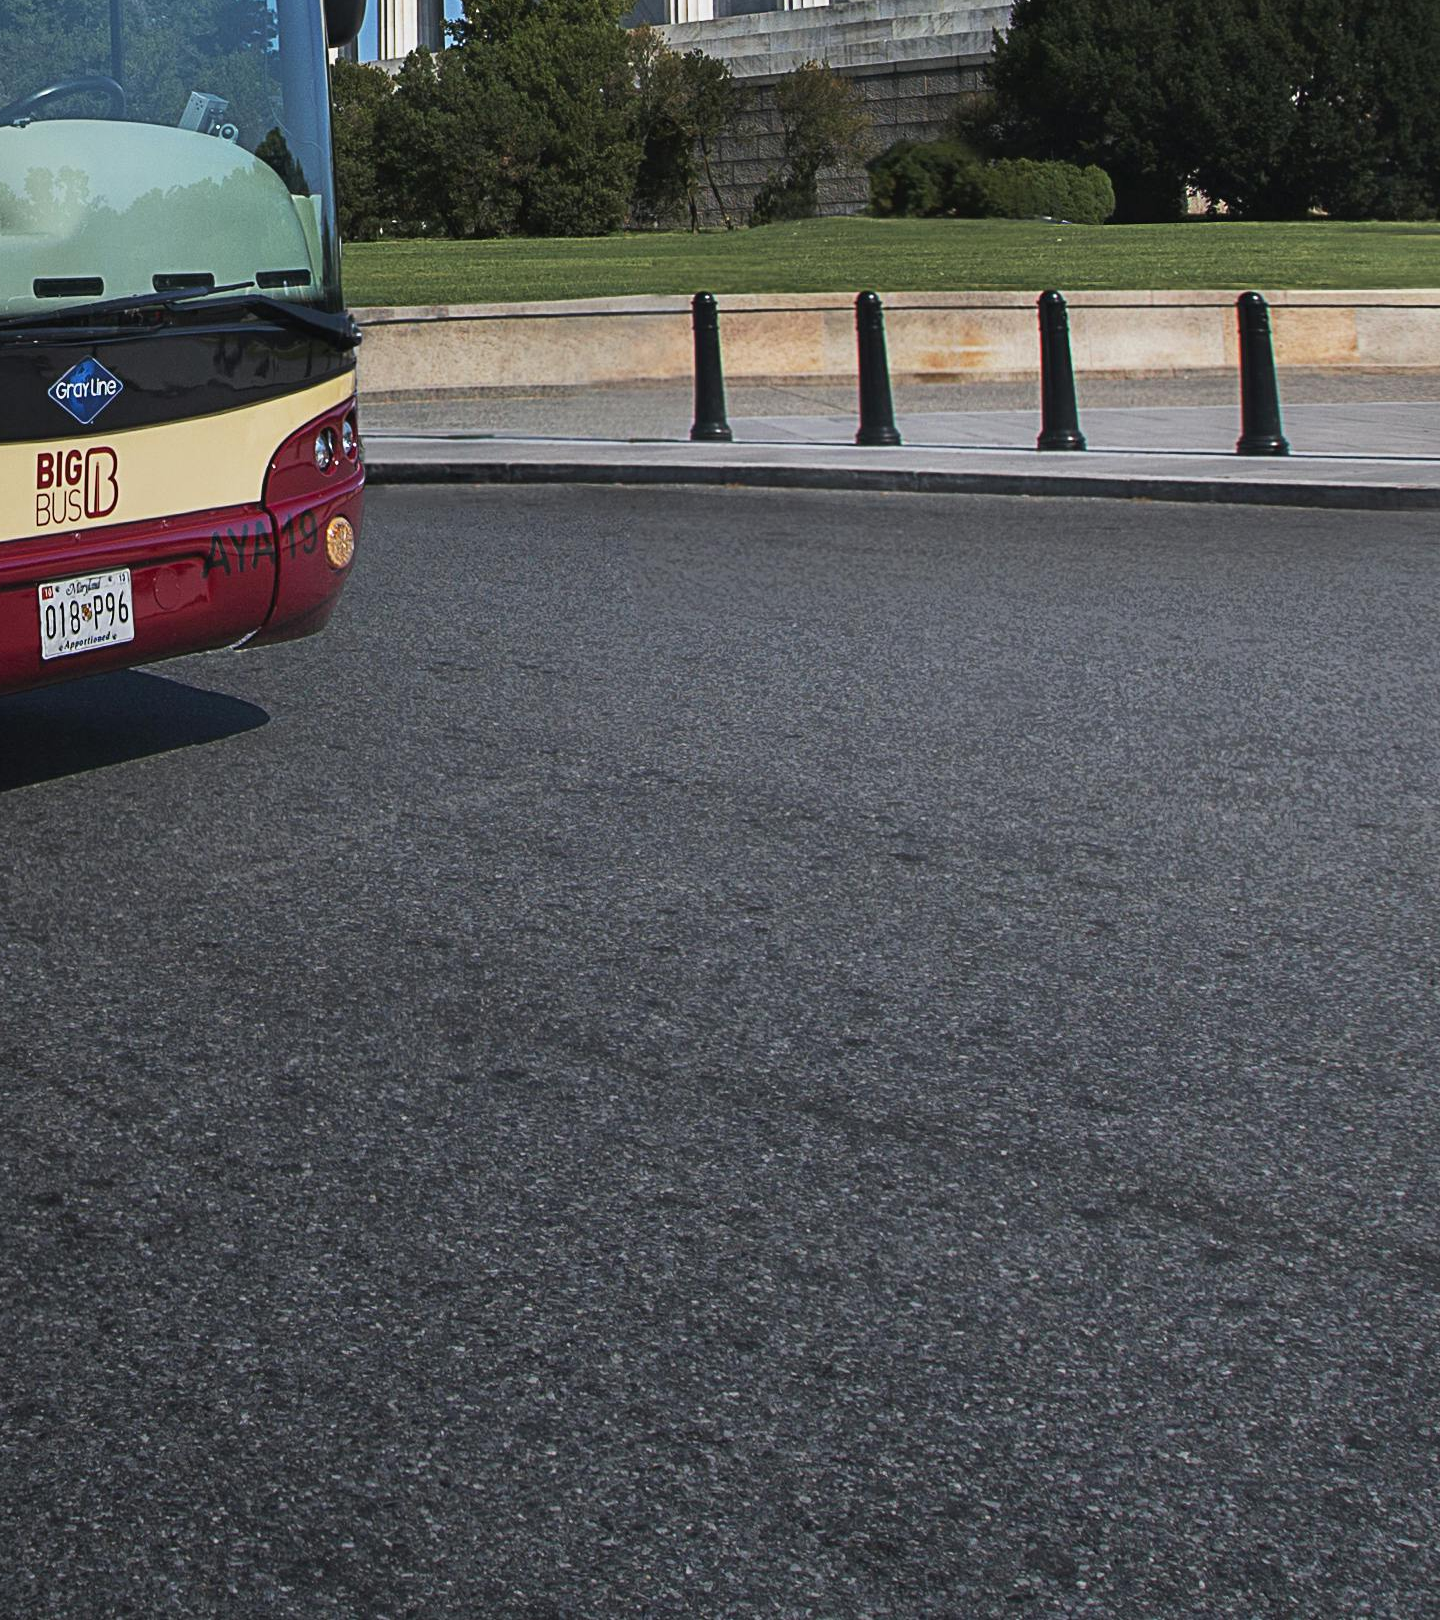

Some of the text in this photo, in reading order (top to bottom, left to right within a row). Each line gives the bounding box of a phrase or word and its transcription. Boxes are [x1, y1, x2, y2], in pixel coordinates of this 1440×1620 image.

[36, 449, 83, 490] BIG
[36, 488, 82, 527] BUS
[281, 509, 318, 559] 19
[64, 631, 112, 651] Apportioned
